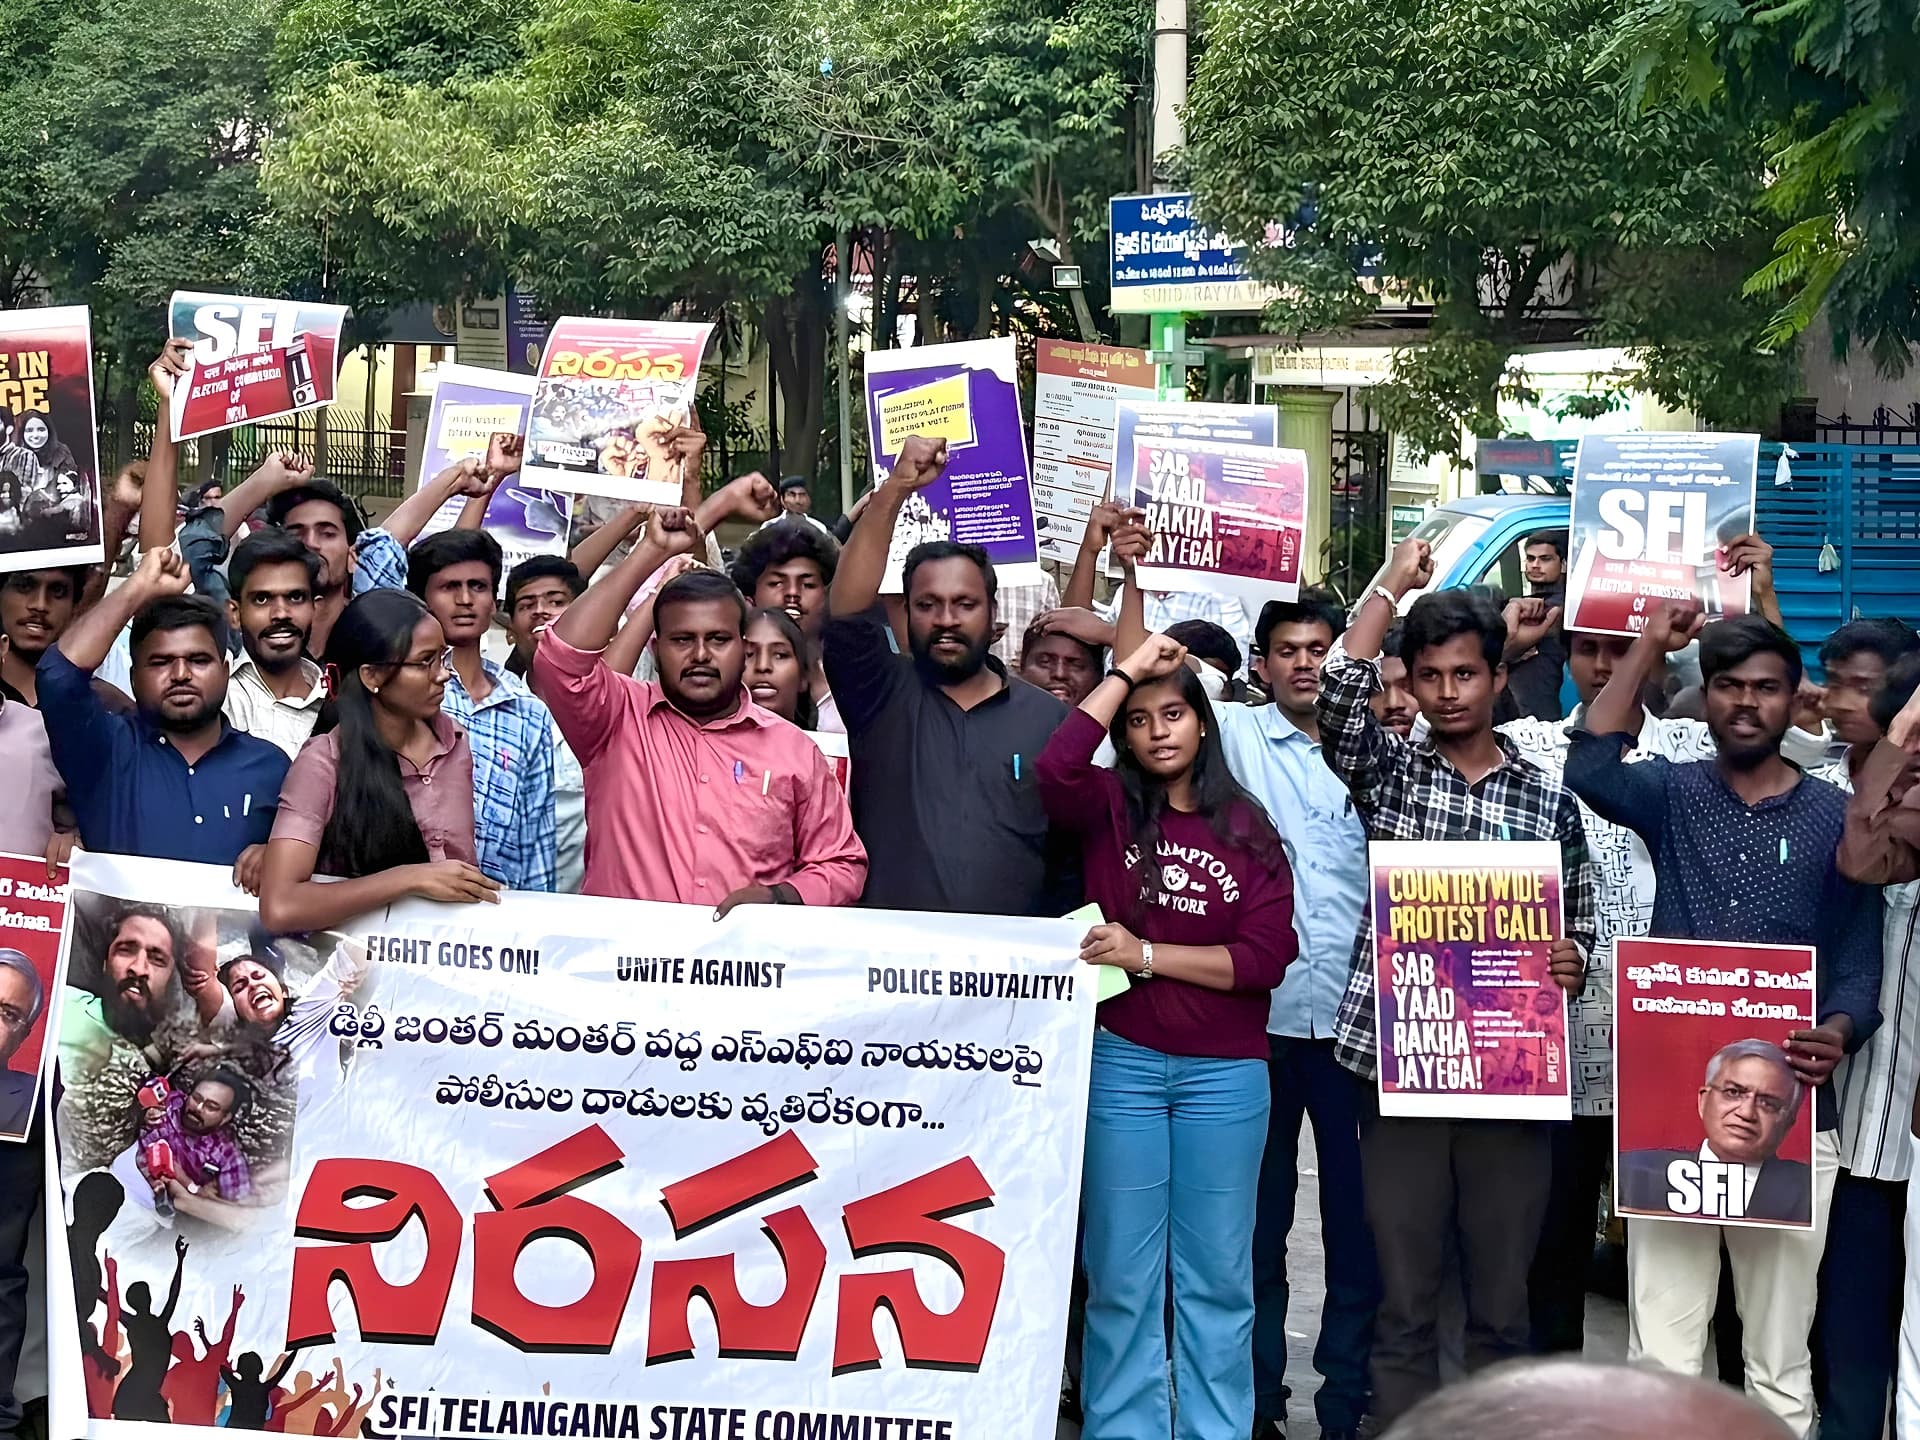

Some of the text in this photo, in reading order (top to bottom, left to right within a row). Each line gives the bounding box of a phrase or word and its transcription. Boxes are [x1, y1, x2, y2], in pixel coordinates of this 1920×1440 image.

[193, 304, 299, 365] SFI
[17, 351, 49, 379] IN
[550, 348, 685, 382] నిరసన
[230, 388, 241, 403] OF
[1149, 449, 1190, 477] SAB
[1149, 472, 1206, 506] YAAD
[1144, 503, 1214, 539] RAKHA
[1597, 488, 1707, 566] SFI
[1144, 533, 1224, 569] AYEGA!
[1633, 597, 1645, 612] OF
[1388, 868, 1547, 905] COUNTRYWIDE
[1172, 896, 1208, 916] YORK
[1389, 905, 1553, 944] PROTEST CALL
[366, 935, 1074, 1002] FIGHT GOES ON! UNITE AGAINST POLICE BRUTALITY!
[1391, 951, 1436, 987] SAB
[1391, 986, 1455, 1020] YAAD
[394, 1012, 505, 1048] జంతర్
[512, 1021, 637, 1057] మంతర్
[645, 1028, 703, 1072] వద్ద
[711, 1030, 854, 1071] ఎస్ఎఫ్ఐ
[860, 1038, 1044, 1088] నాయకులపై
[1393, 1020, 1471, 1057] RAKHA
[1396, 1056, 1483, 1091] JAYEGA!
[435, 1073, 945, 1137] పోలీసుల దాడులకు వ్యతిరేకంగా...
[1667, 1159, 1746, 1219] SFI
[285, 1123, 1006, 1376] నిరసన
[378, 1394, 430, 1431] SFI
[439, 1397, 641, 1440] TELANGANA
[649, 1405, 746, 1440] STATE
